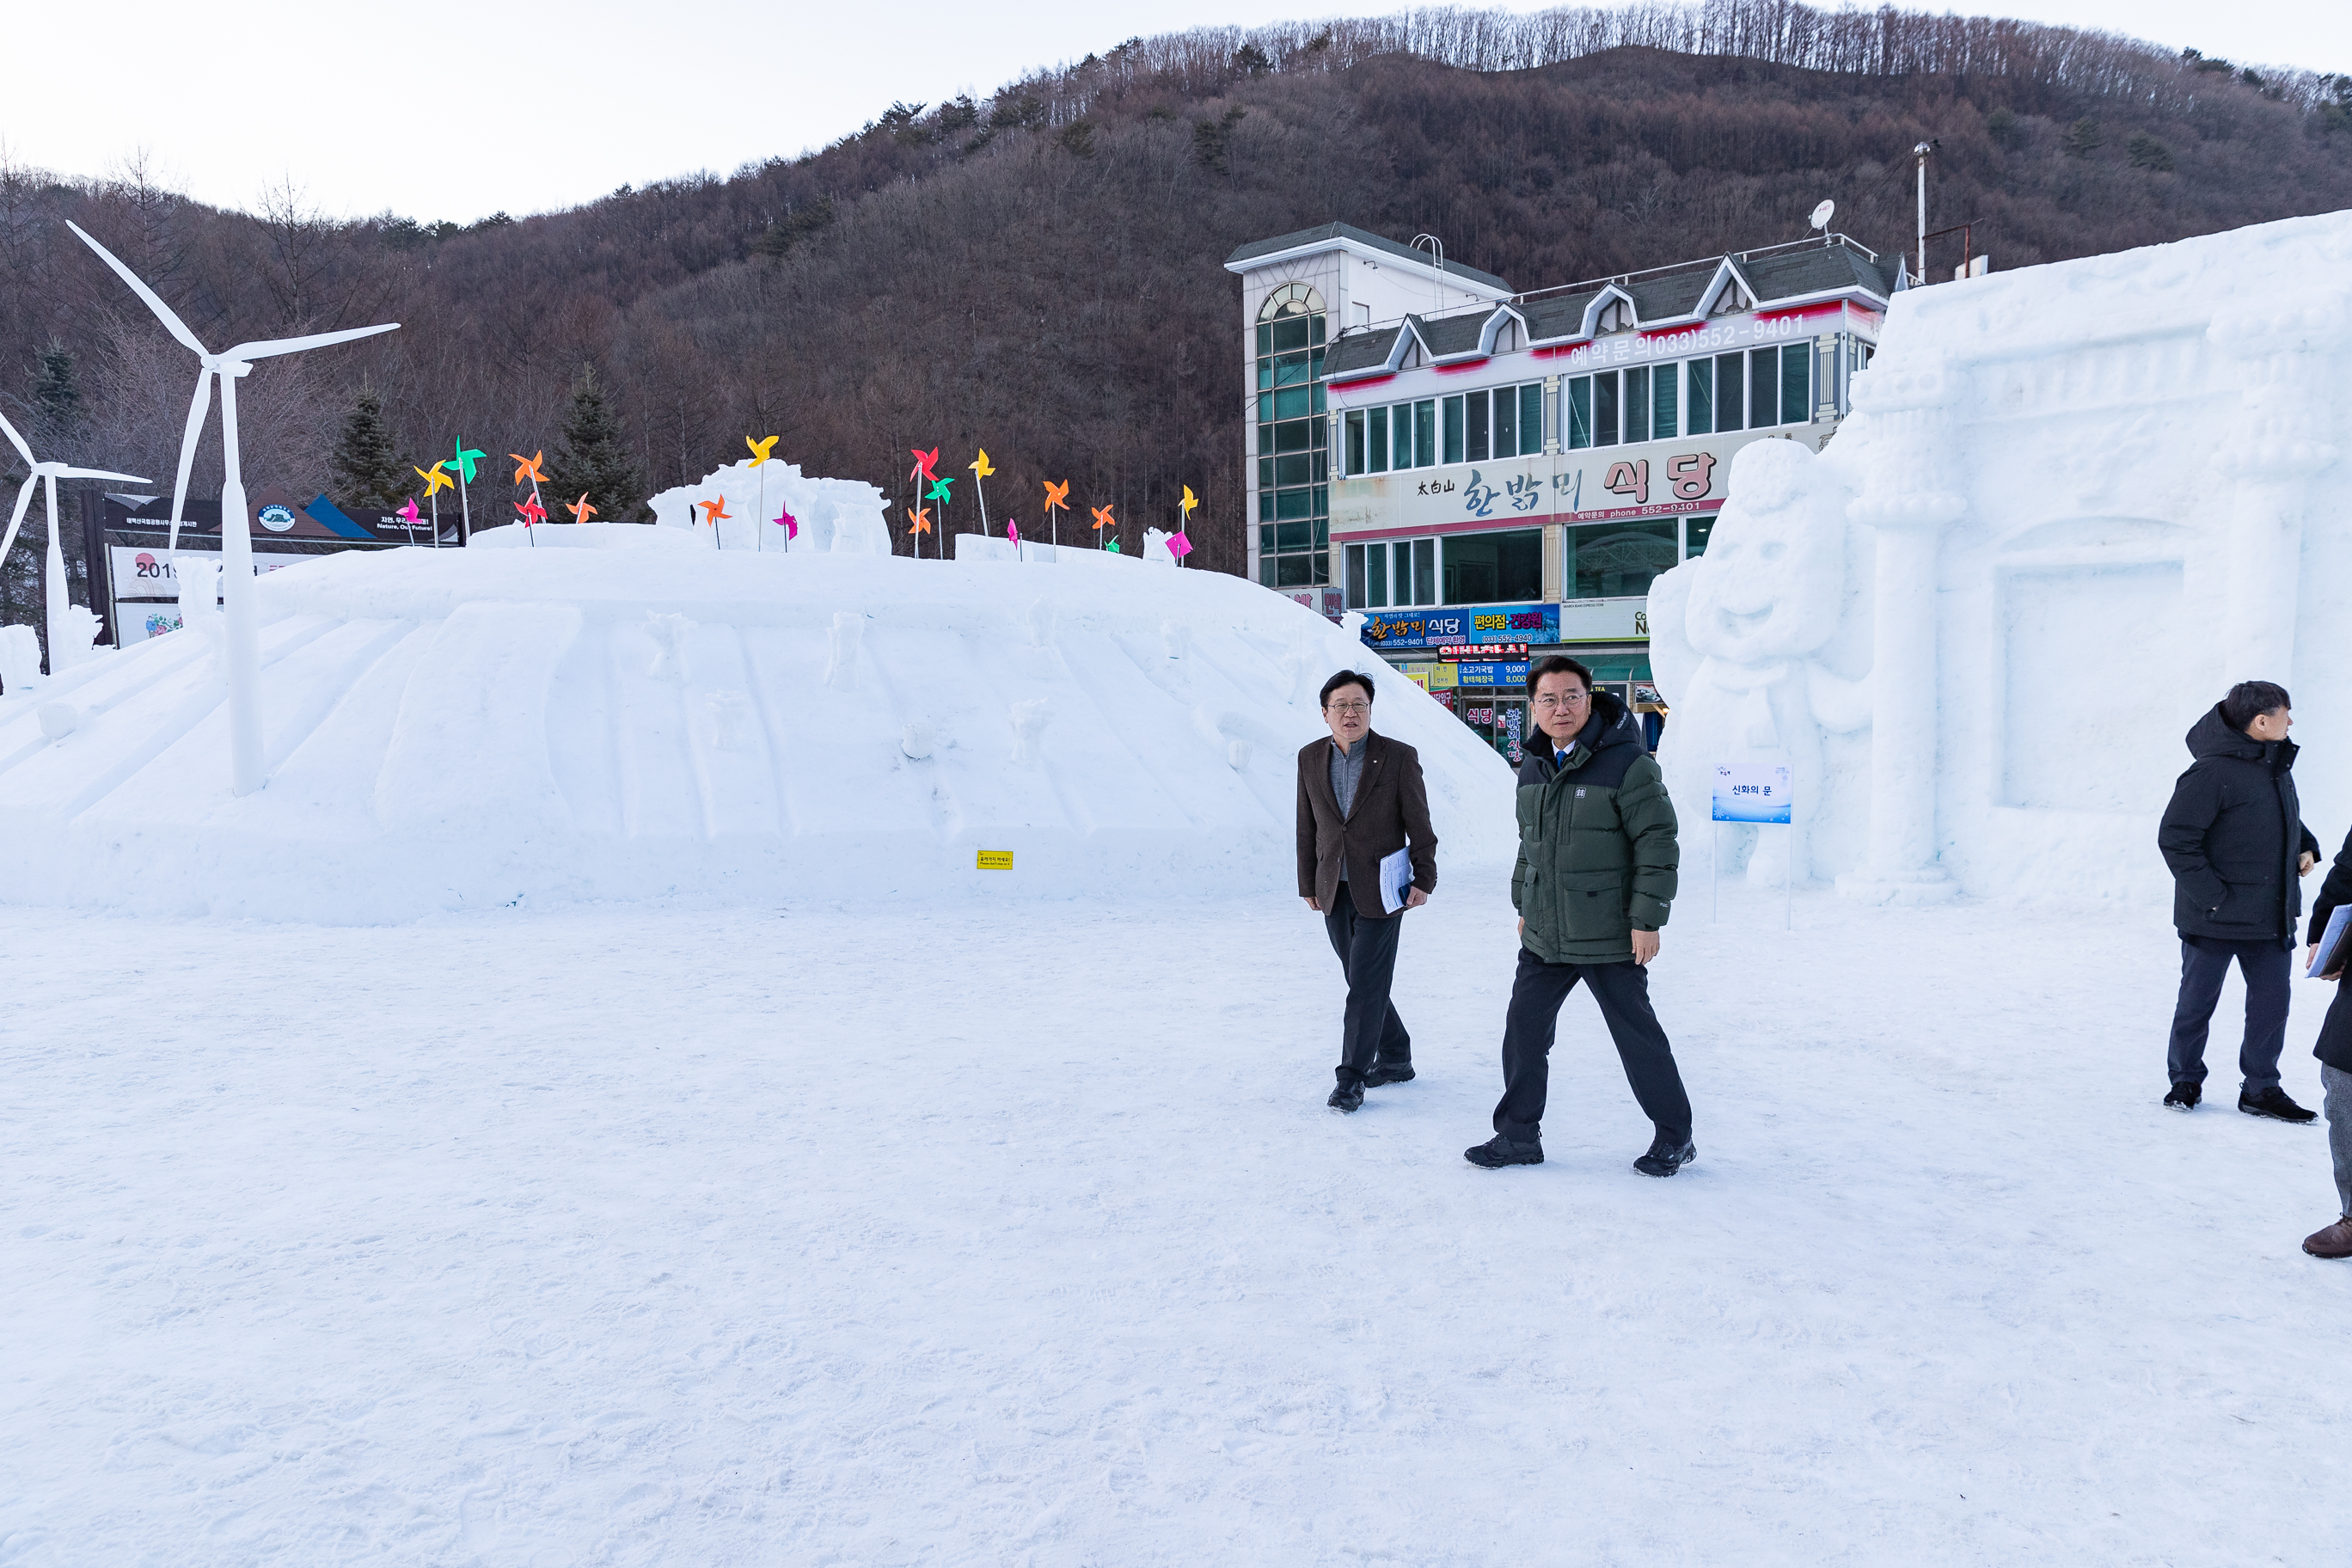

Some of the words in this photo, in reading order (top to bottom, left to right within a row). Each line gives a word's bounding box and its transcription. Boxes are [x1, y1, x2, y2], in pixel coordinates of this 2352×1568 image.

[1571, 333, 1652, 367] 예약문의
[1604, 452, 1718, 504] 식당
[1418, 478, 1455, 497] 太白山
[1577, 511, 1605, 520] 예약문의
[1610, 510, 1637, 518] phone
[1642, 502, 1700, 515] 552-9401
[1428, 618, 1461, 634] 식당
[1498, 634, 1533, 642] 552-4940
[1462, 665, 1494, 674] 소고기국밥
[1505, 665, 1526, 674] 9,000
[1467, 707, 1493, 724] 식당
[1732, 785, 1759, 795] 신화의
[1762, 786, 1772, 796] 문
